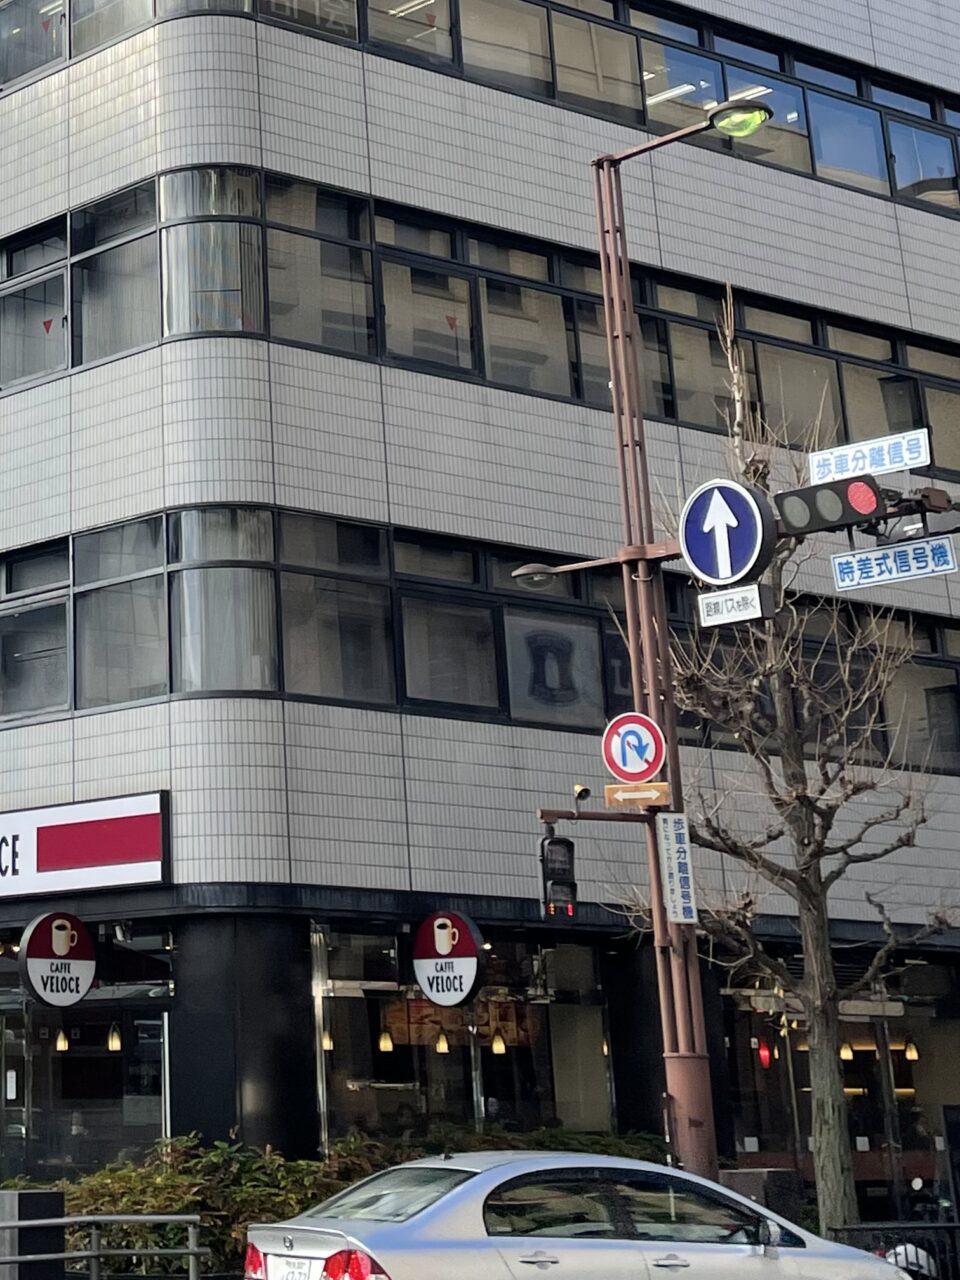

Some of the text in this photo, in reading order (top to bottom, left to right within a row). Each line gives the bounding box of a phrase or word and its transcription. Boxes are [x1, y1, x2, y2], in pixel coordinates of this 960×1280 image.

[816, 437, 923, 480] 歩車分離信号
[837, 543, 951, 583] 時差式信号機
[41, 974, 81, 994] VELOCE
[426, 974, 464, 993] VELOCE
